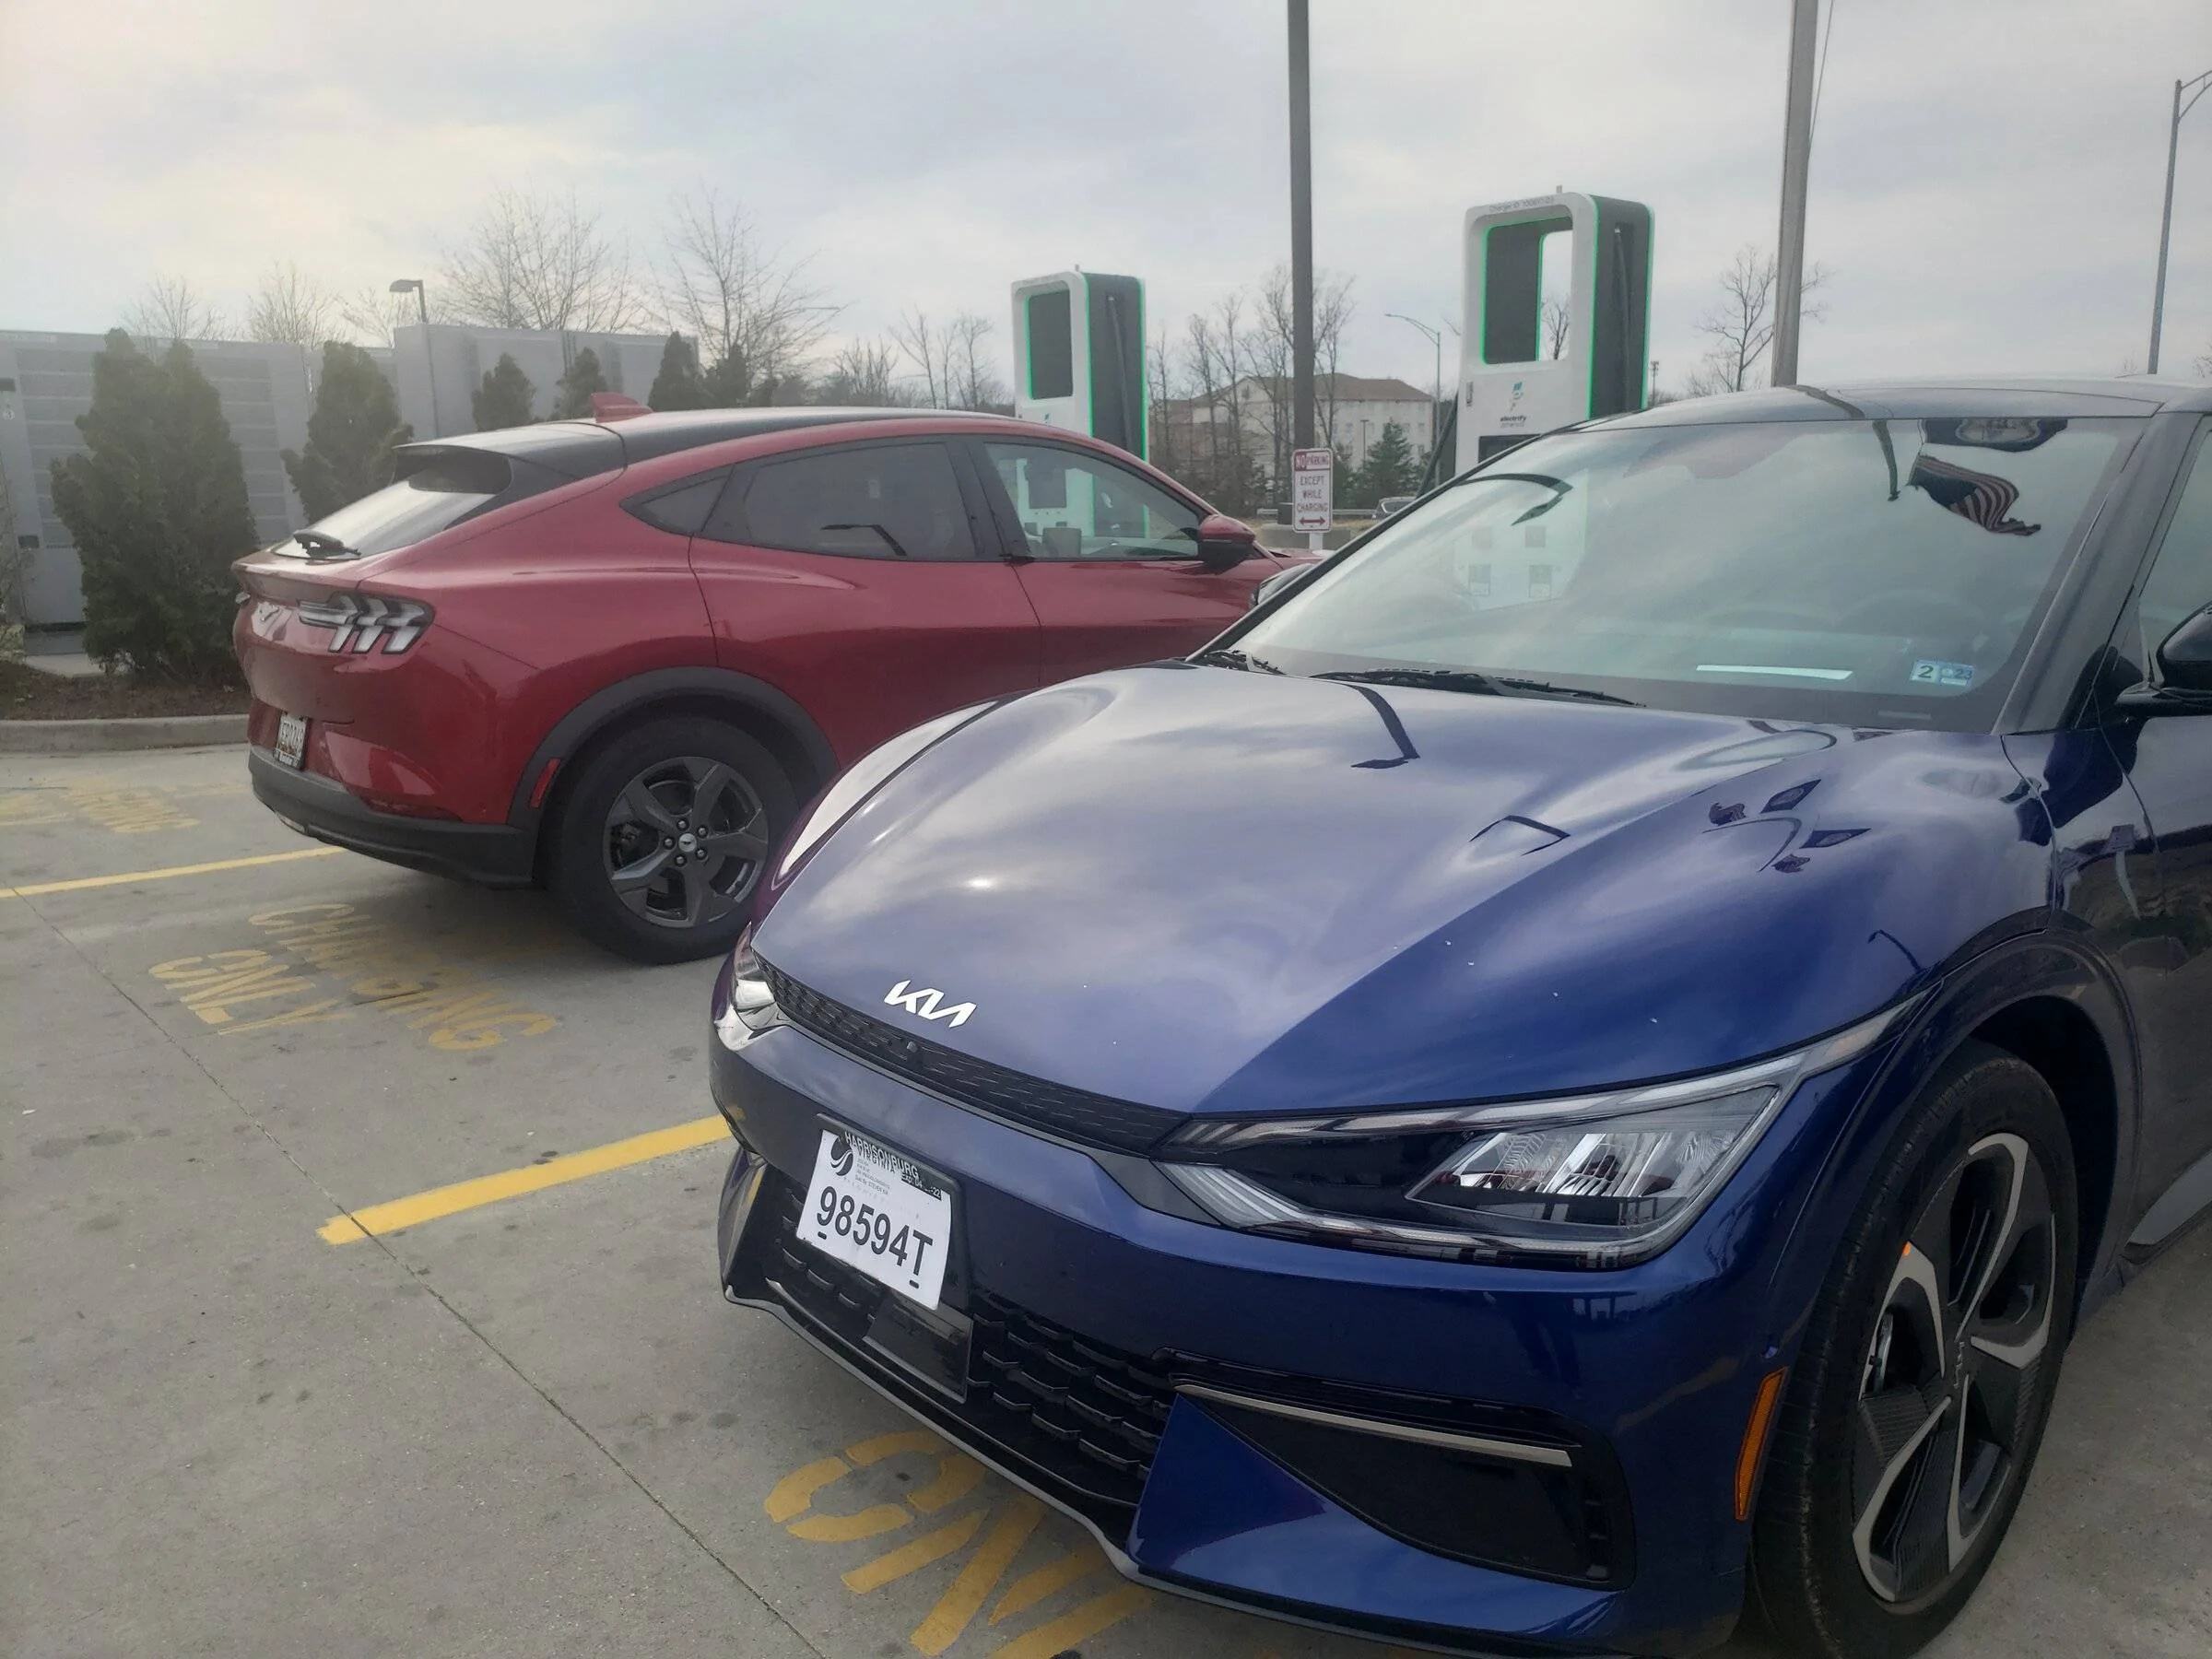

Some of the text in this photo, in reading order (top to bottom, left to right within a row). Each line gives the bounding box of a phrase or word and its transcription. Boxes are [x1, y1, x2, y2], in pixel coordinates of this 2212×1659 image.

[1306, 454, 1329, 465] PARKING
[1300, 476, 1324, 487] EXCEPT
[1302, 489, 1323, 500] WHILE
[1297, 503, 1328, 513] CHARGING
[1918, 665, 1934, 678] 2
[883, 980, 977, 1028] KIA
[844, 1131, 920, 1180] HARRISONBURG
[817, 1185, 934, 1277] 98594T
